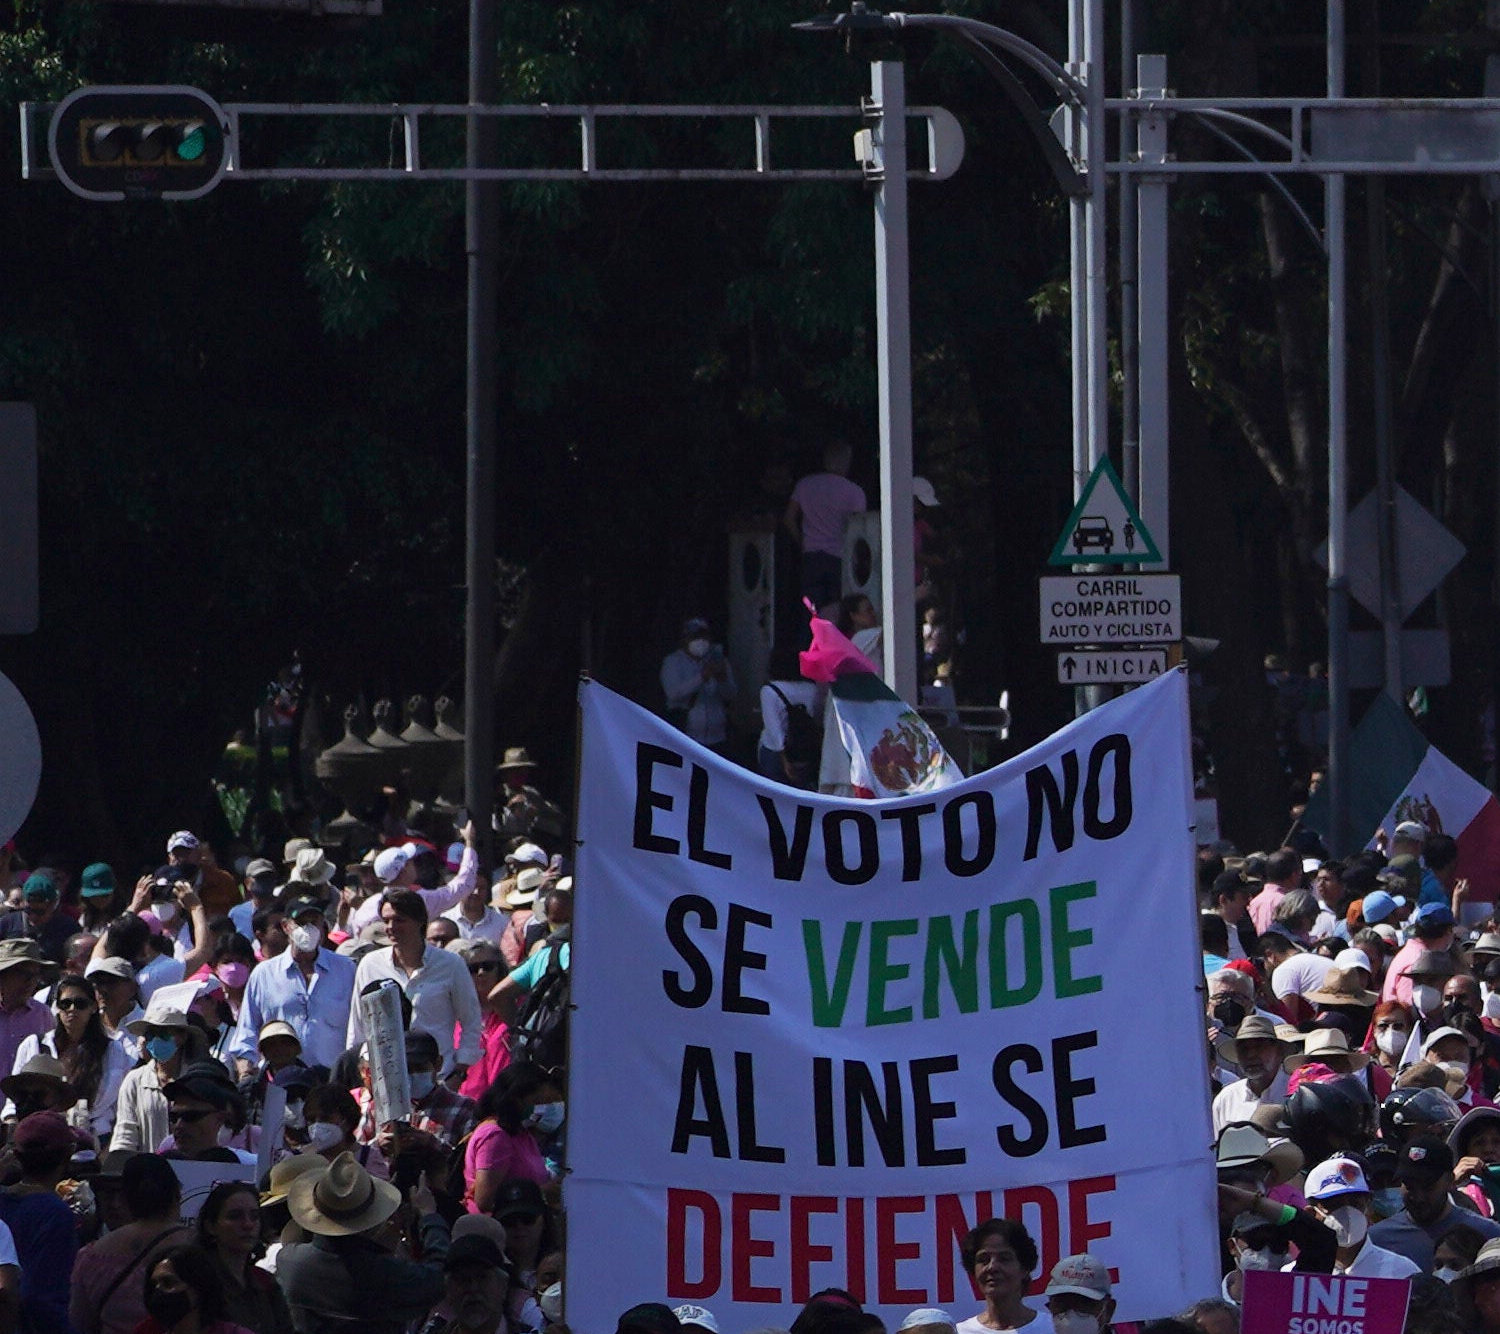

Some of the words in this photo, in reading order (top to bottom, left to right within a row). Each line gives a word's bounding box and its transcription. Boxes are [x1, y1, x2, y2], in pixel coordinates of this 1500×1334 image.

[1077, 580, 1143, 596] CARRIL
[1052, 600, 1171, 617] COMPARTIDO
[1049, 624, 1089, 637] AUTO
[1094, 624, 1103, 637] Y
[1107, 623, 1172, 637] CICLISTA
[1087, 660, 1161, 675] INICIA
[632, 741, 732, 871] EL
[756, 789, 997, 885] VOTO
[1021, 732, 1132, 863] NO
[662, 894, 773, 1016] SE
[801, 879, 1103, 1028] VENDE
[670, 1044, 786, 1164] AL
[812, 1054, 967, 1168] INE
[991, 1030, 1106, 1158] SE
[1291, 1275, 1369, 1319] INE
